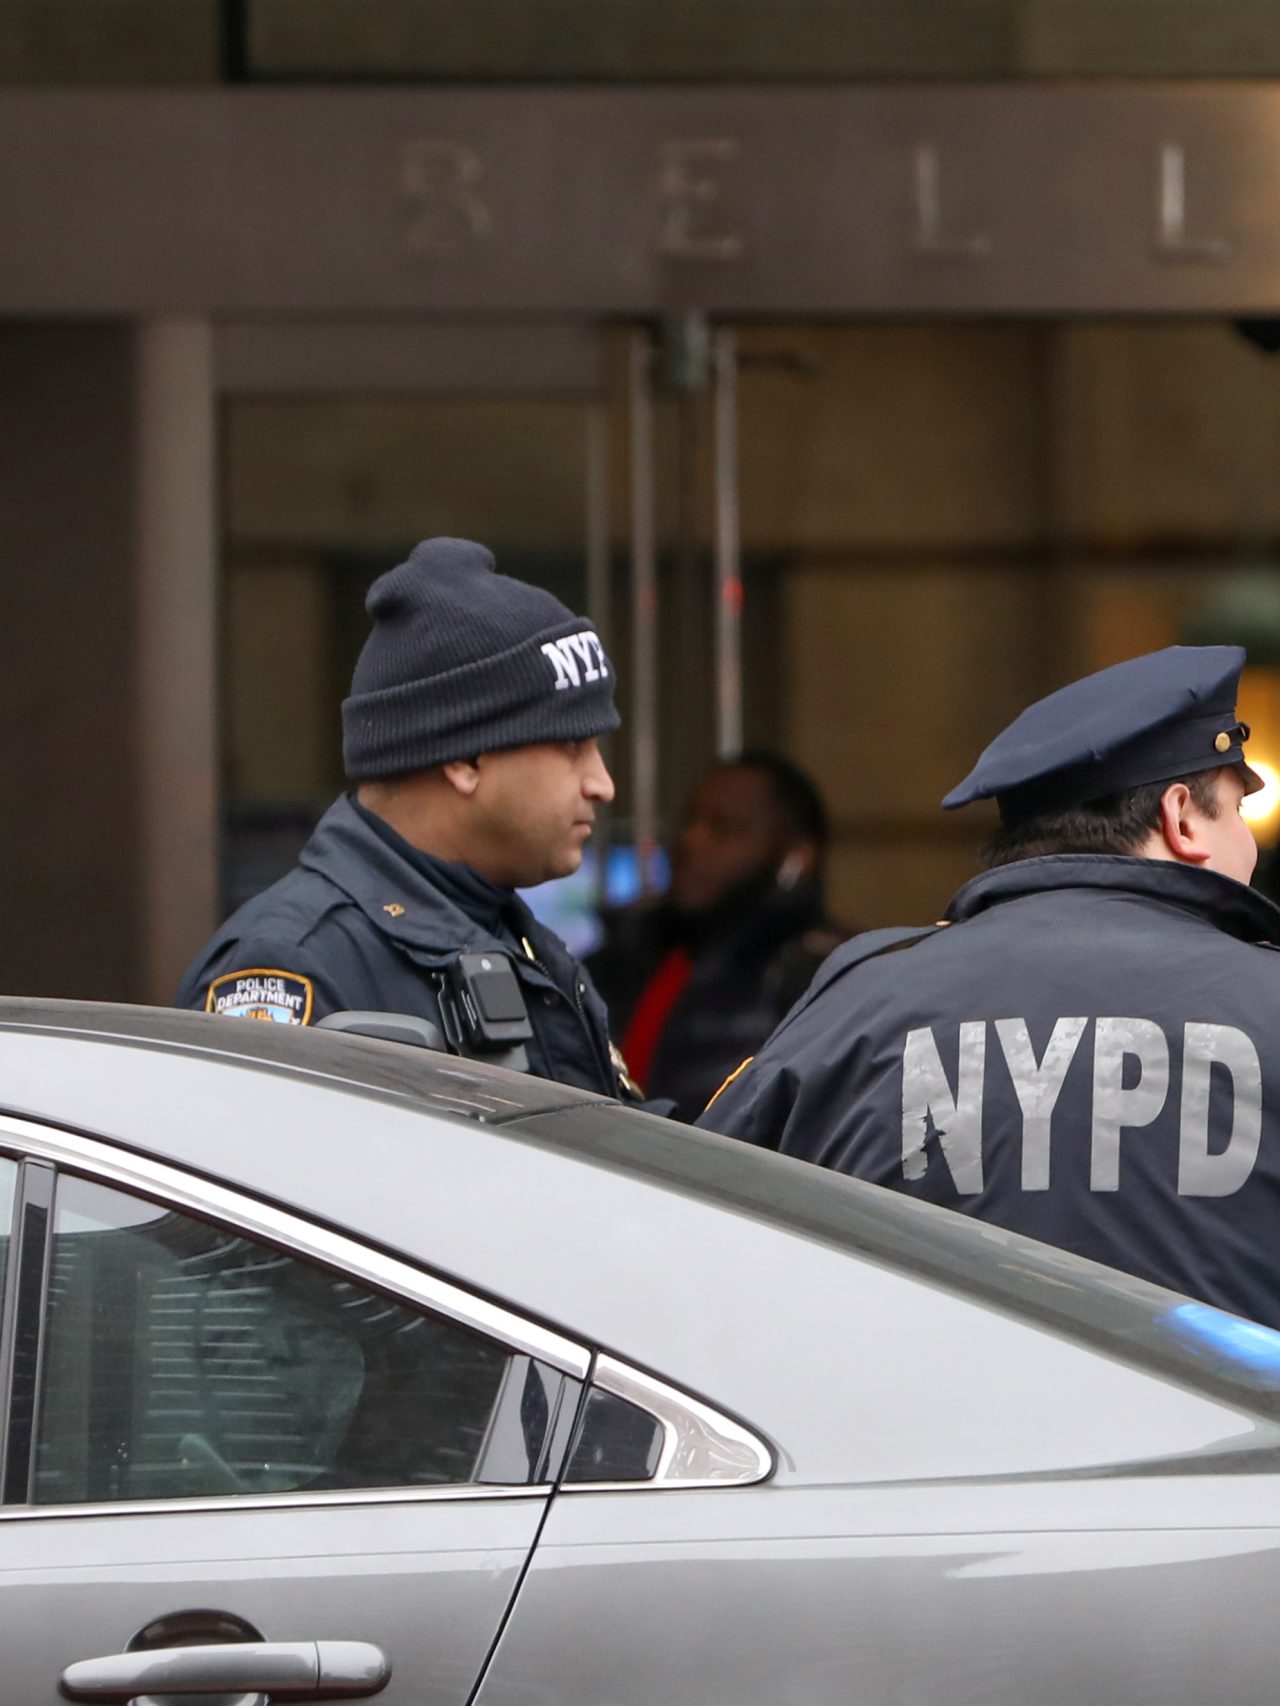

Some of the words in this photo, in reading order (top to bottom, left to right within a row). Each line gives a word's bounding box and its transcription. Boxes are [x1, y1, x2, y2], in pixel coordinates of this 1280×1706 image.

[236, 977, 286, 993] POLICE
[217, 990, 303, 1011] DEPARTMENT
[901, 1016, 1263, 1198] NYPD
